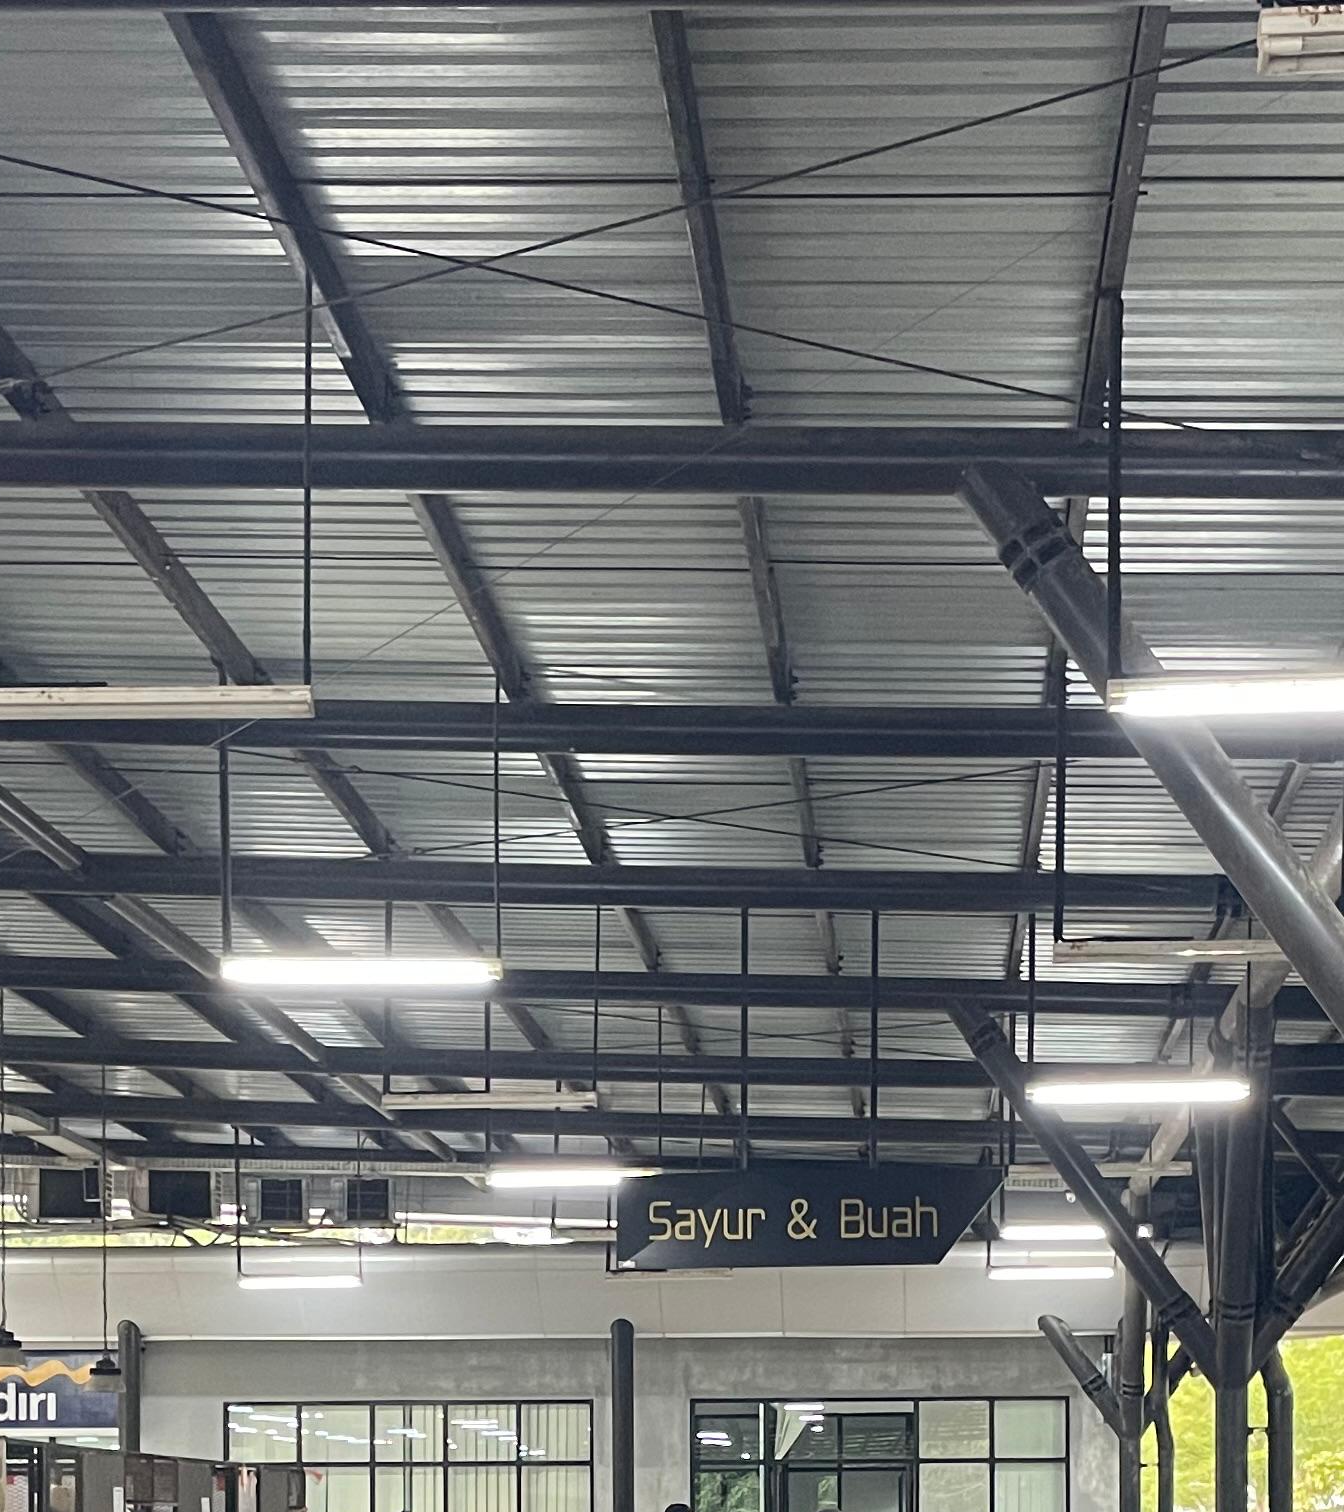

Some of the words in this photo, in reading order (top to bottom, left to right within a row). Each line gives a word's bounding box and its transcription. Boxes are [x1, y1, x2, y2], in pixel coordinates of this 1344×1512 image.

[648, 1201, 765, 1248] Sayur
[787, 1198, 817, 1240] &
[840, 1196, 938, 1239] Buah
